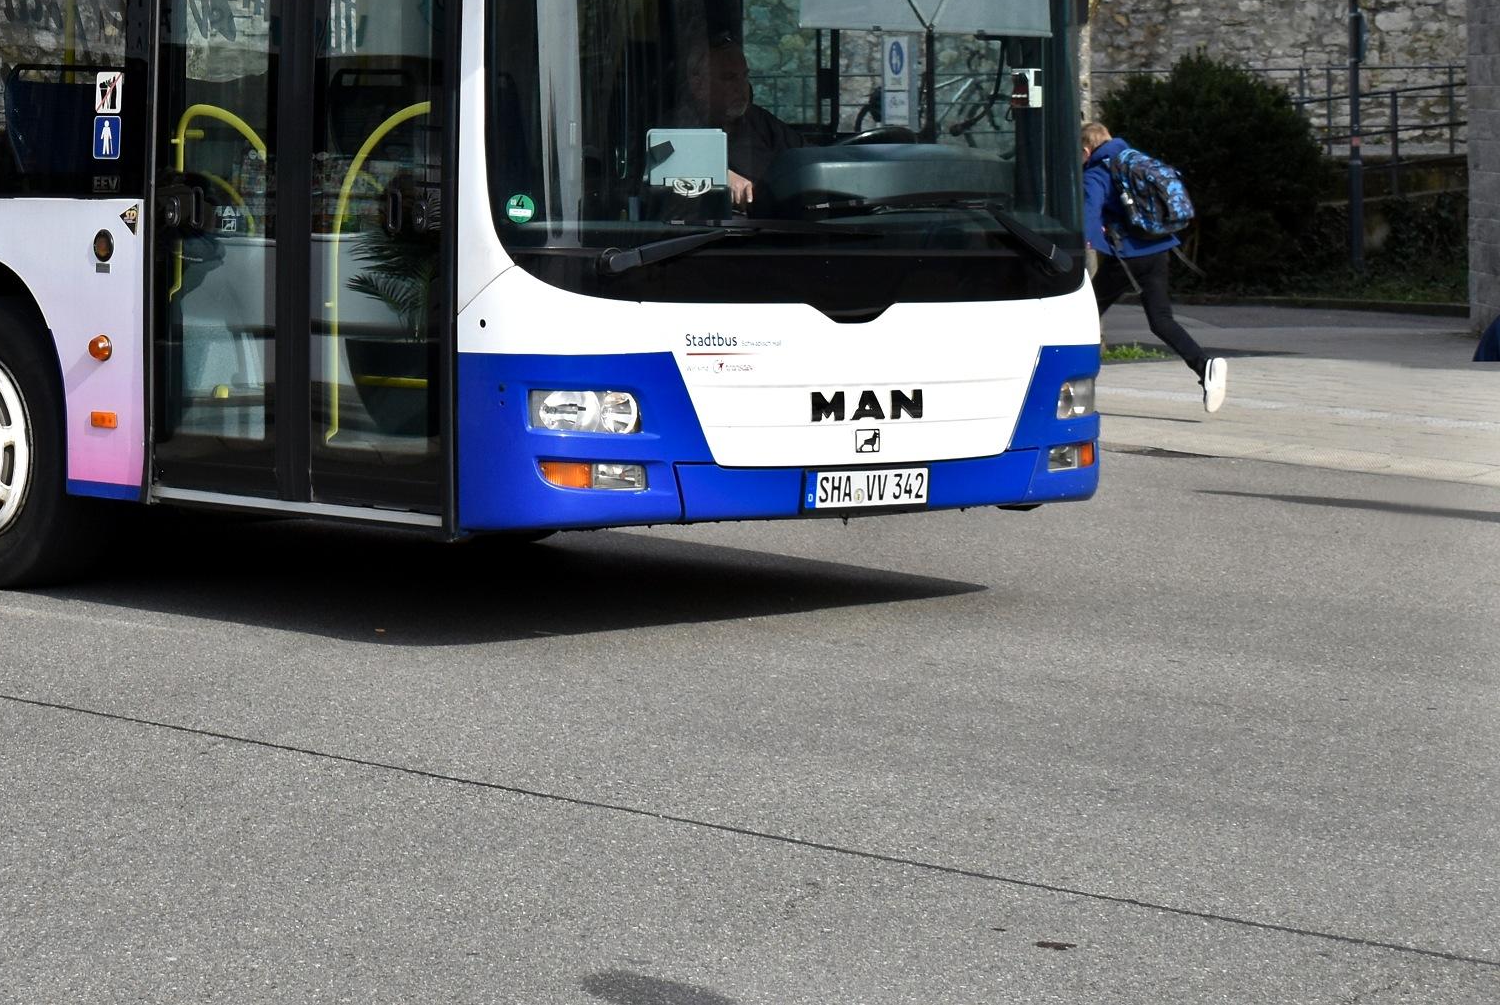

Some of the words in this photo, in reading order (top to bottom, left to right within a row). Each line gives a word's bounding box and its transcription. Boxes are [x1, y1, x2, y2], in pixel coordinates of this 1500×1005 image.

[516, 195, 525, 208] 4
[685, 332, 738, 347] Stadtbus
[811, 389, 923, 422] MAN
[818, 475, 852, 503] SHA
[866, 474, 888, 501] VV
[892, 472, 924, 500] 342
